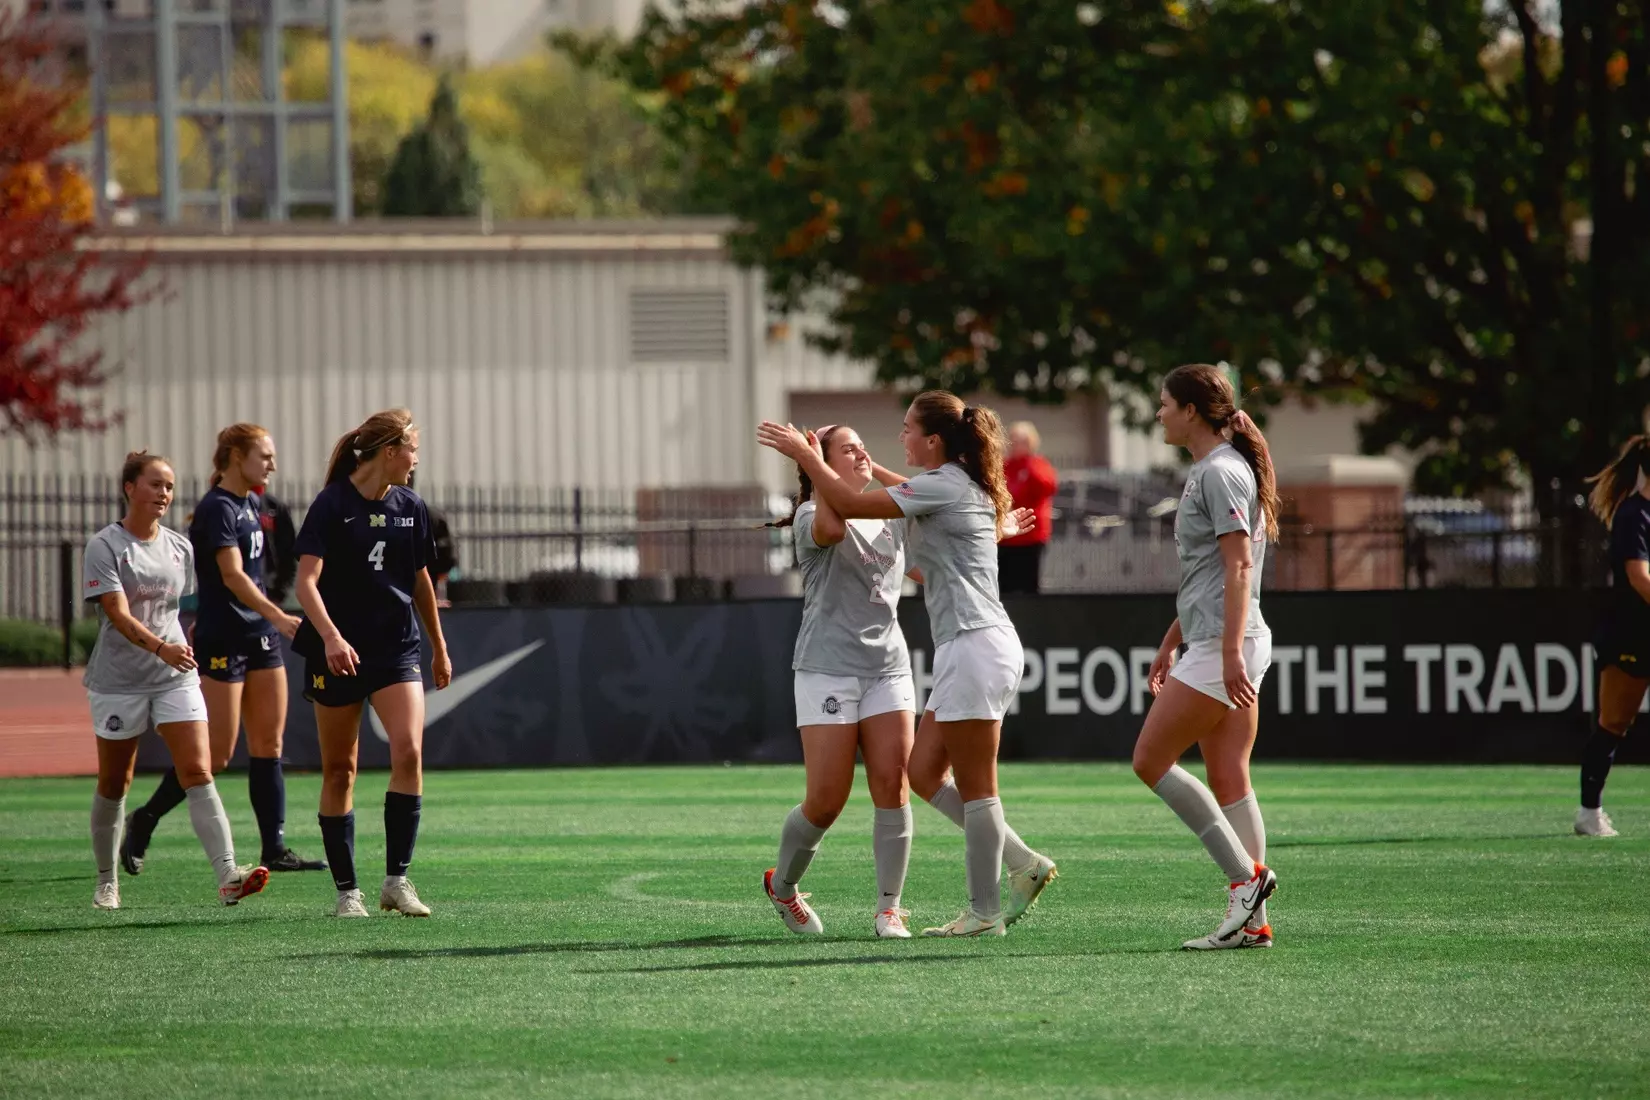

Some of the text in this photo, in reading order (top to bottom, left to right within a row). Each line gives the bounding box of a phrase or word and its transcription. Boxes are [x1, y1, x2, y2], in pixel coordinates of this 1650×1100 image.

[369, 514, 386, 527] M
[367, 541, 386, 570] 4
[1009, 645, 1180, 716] PEOP
[1269, 644, 1387, 714] THE
[1403, 642, 1650, 713] TRADI
